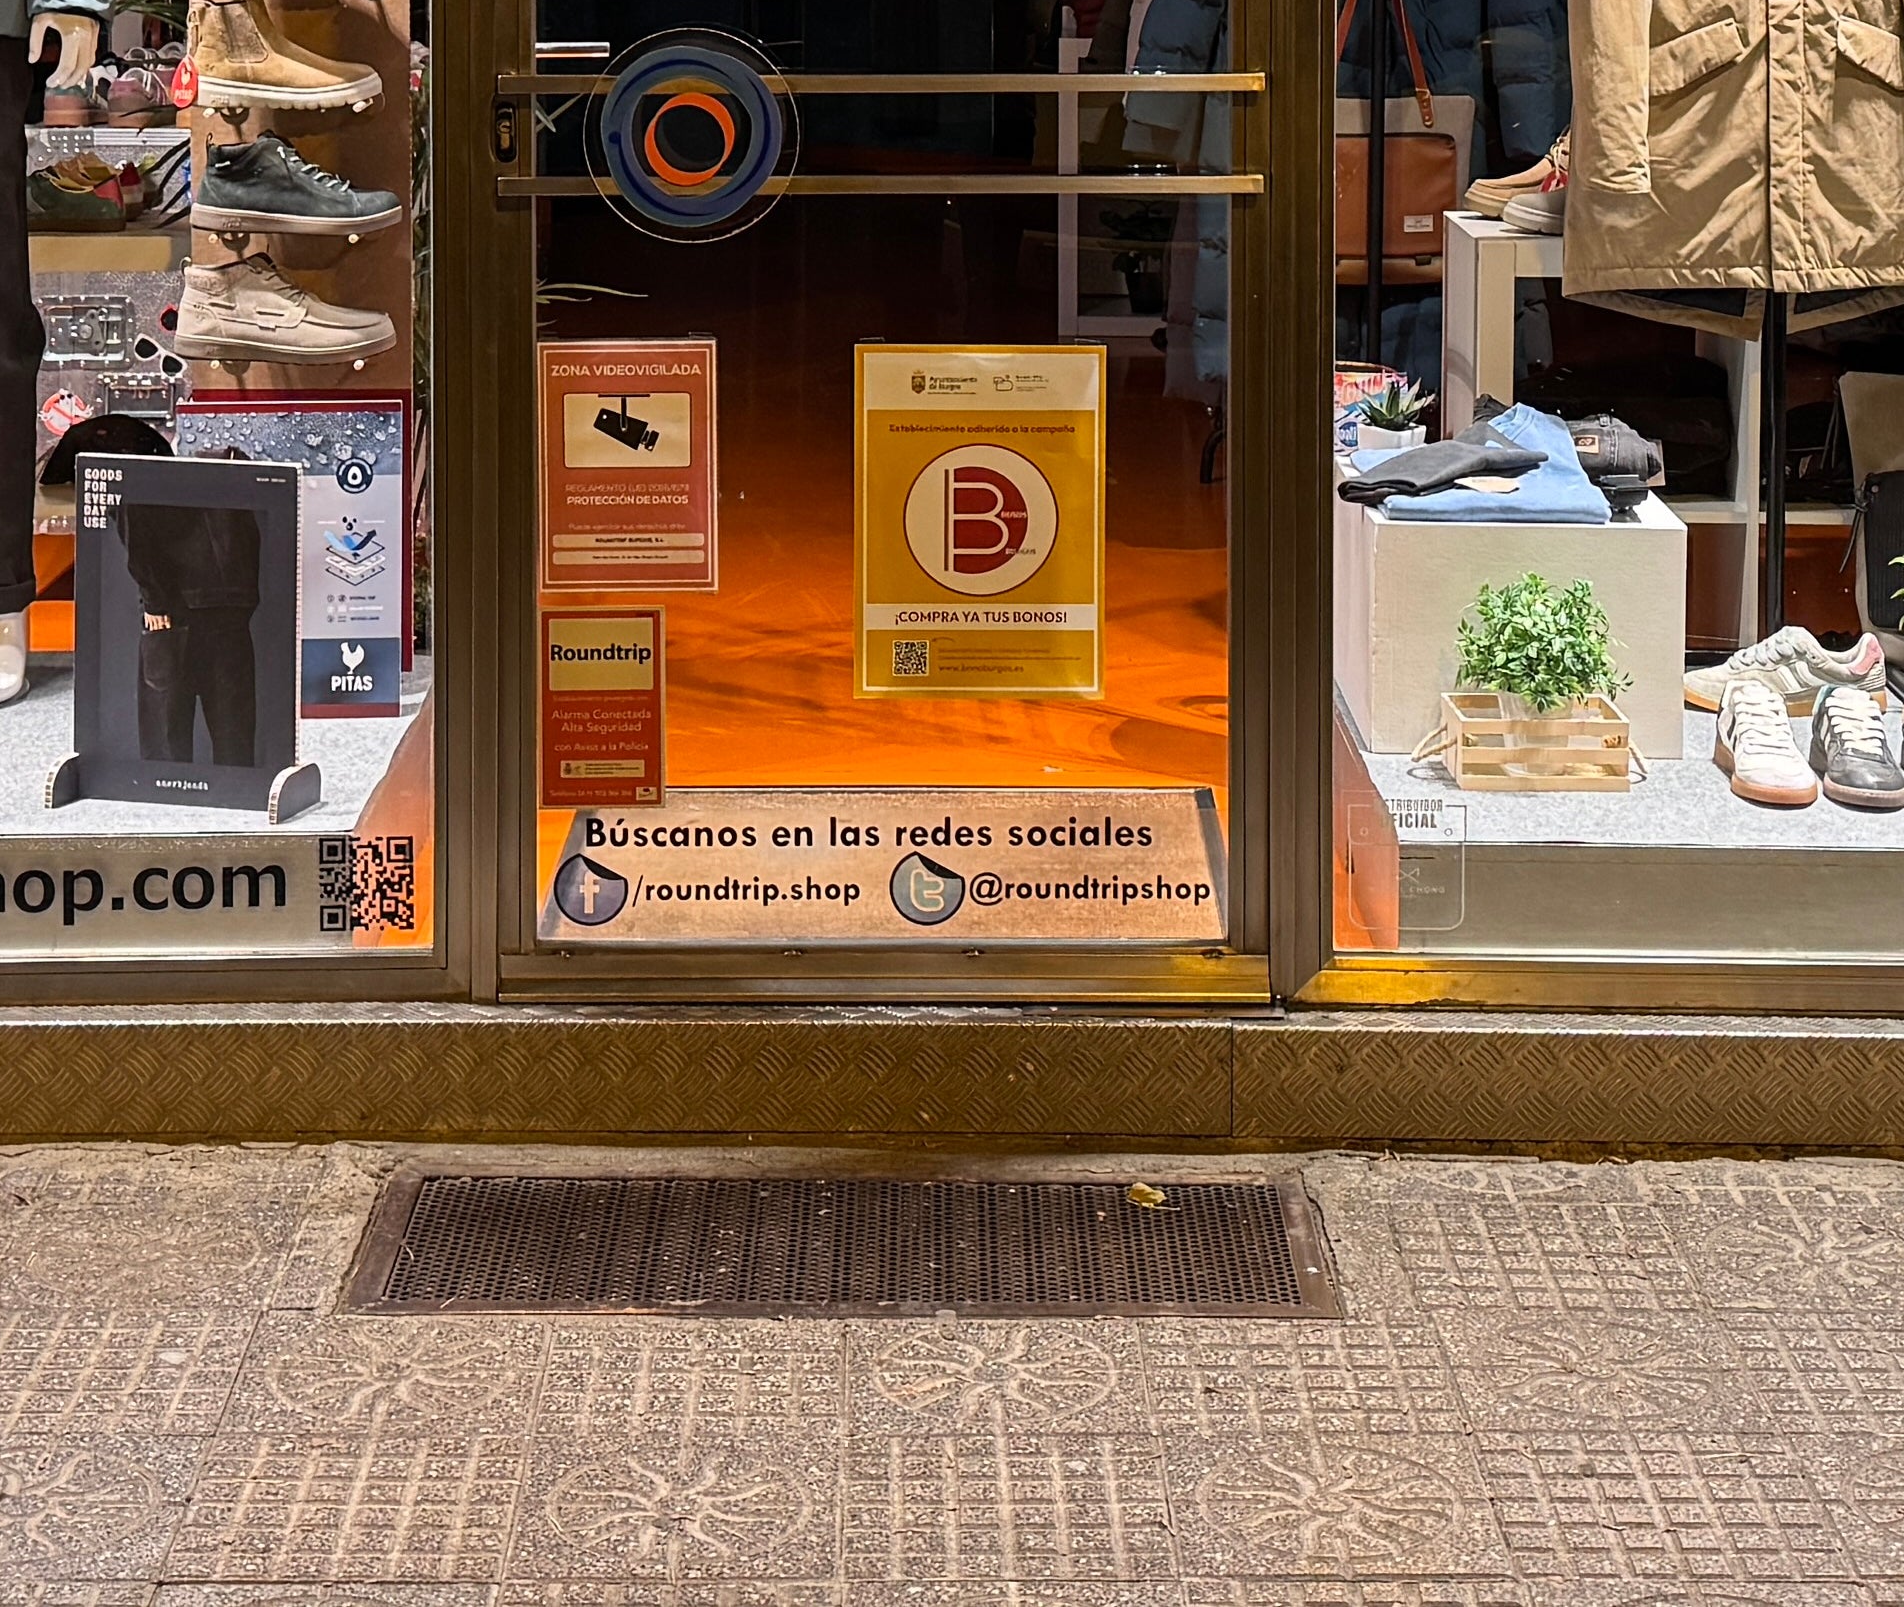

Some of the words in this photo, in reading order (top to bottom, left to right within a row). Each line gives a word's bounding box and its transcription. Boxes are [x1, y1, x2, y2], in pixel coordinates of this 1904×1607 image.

[551, 364, 590, 377] ZONA
[594, 364, 702, 376] VIDEOVIGILADA
[889, 425, 966, 433] Establecimiento
[967, 425, 1010, 433] adherido
[84, 467, 123, 482] GOODS
[84, 480, 107, 493] FOR
[84, 493, 122, 506] EVERY
[566, 493, 635, 505] PROTECCIÓN
[636, 495, 651, 505] DE
[654, 495, 689, 505] DATOS
[84, 505, 106, 517] DAY
[83, 516, 107, 529] USE
[895, 611, 960, 625] ¡COMPRA
[962, 611, 980, 623] YA
[984, 611, 1010, 623] TUS
[1012, 611, 1067, 623] BONOS!
[550, 643, 652, 665] Roundtrip
[331, 675, 373, 692] PITAS
[551, 710, 590, 720] Alarma
[593, 708, 652, 720] Conectada
[561, 722, 583, 732] Alta
[586, 722, 642, 734] Seguridad
[584, 817, 759, 848] Búscanos
[771, 824, 814, 848] en
[828, 817, 881, 848] las
[895, 817, 994, 848] redes
[1007, 817, 1154, 848] sociales
[631, 875, 861, 909] /roundtrip.shop
[969, 872, 1212, 909] @roundtripshop
